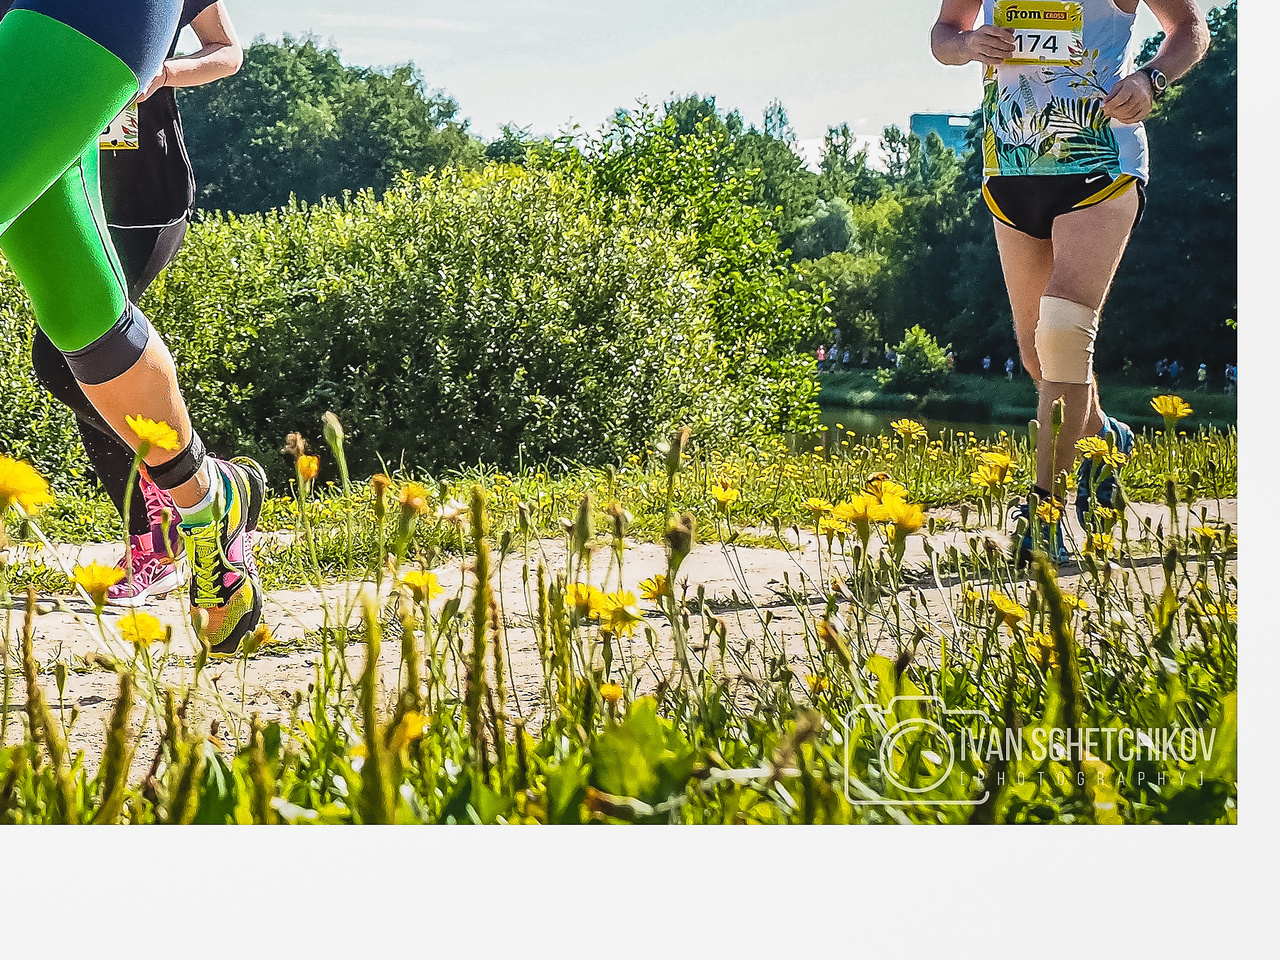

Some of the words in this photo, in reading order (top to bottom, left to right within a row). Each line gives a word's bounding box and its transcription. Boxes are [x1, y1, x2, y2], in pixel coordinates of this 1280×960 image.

[1006, 8, 1042, 22] grom
[1045, 12, 1065, 20] CROSS
[1014, 34, 1059, 53] 174
